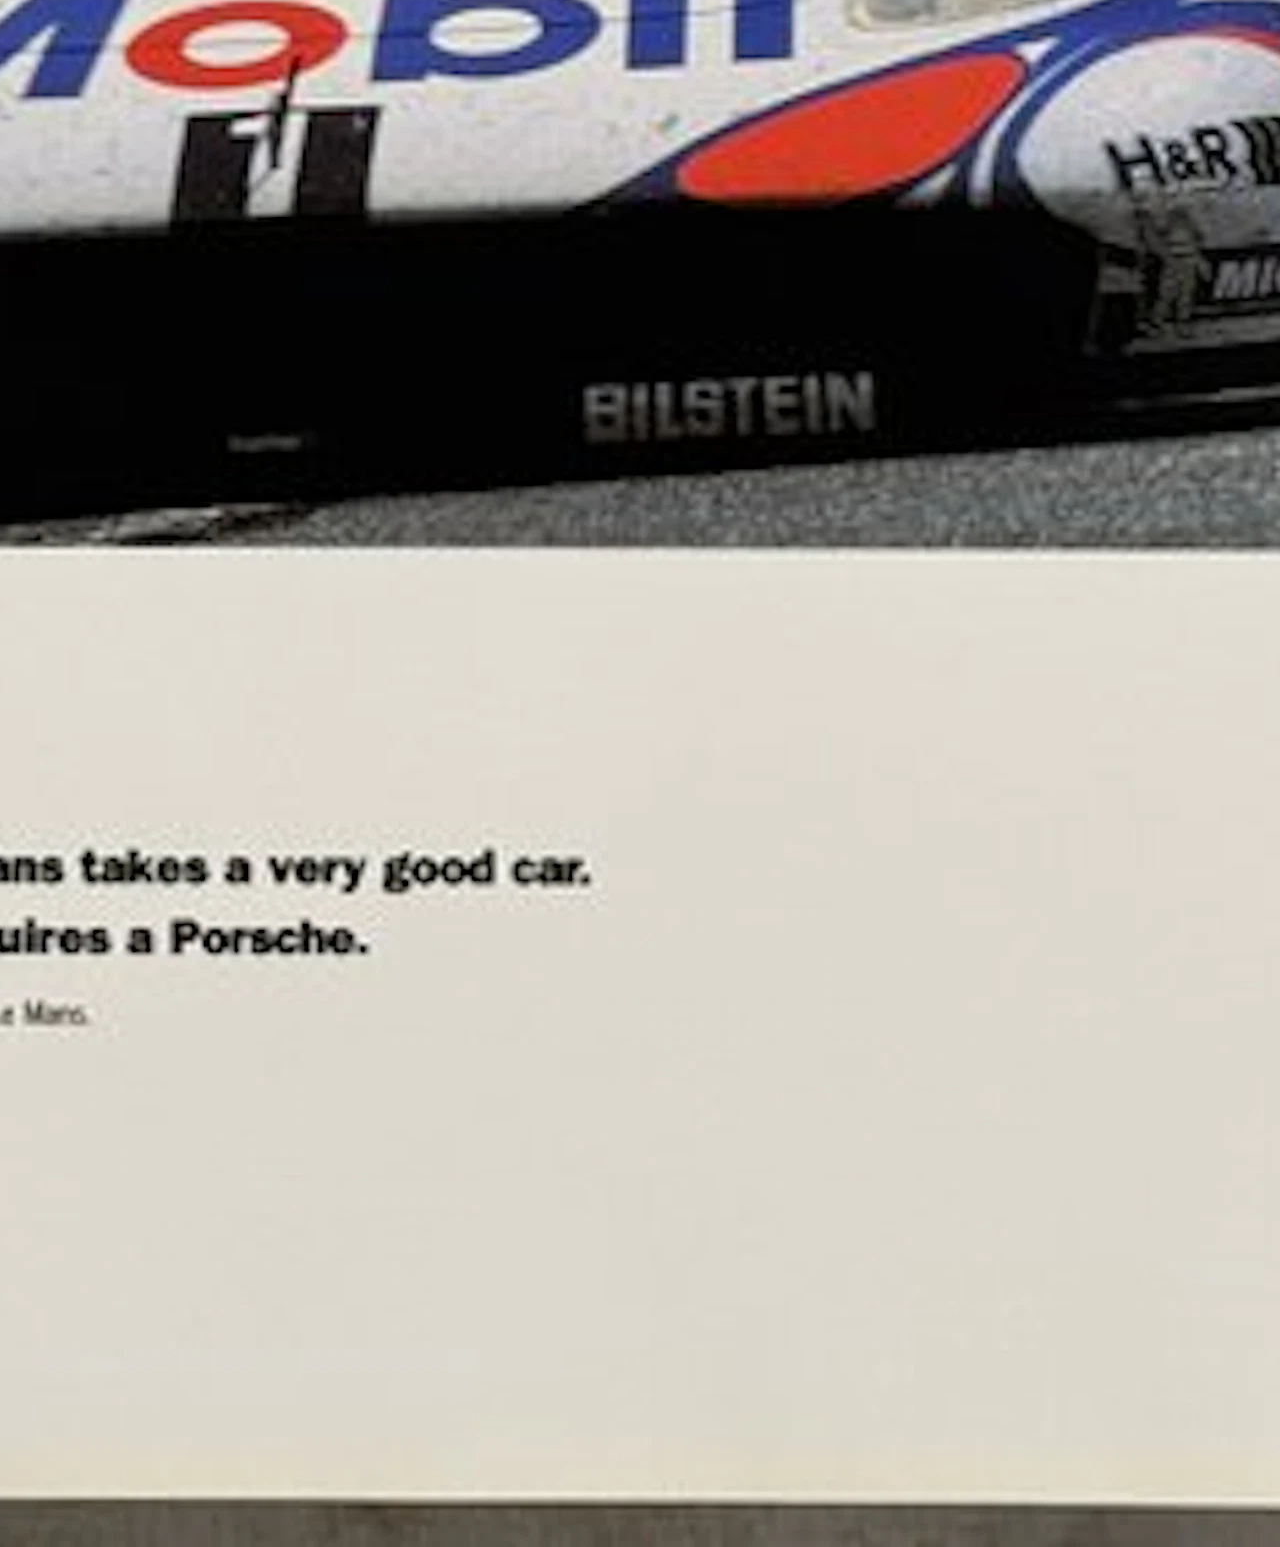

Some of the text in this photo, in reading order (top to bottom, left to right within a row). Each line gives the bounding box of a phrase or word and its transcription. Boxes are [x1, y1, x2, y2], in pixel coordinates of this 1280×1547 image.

[582, 371, 876, 442] BILSTEIN
[78, 848, 212, 887] takes
[222, 855, 253, 886] a
[266, 855, 368, 895] very
[381, 848, 497, 895] good
[509, 855, 592, 888] car.
[124, 926, 155, 956] a
[169, 917, 370, 957] Porsche.
